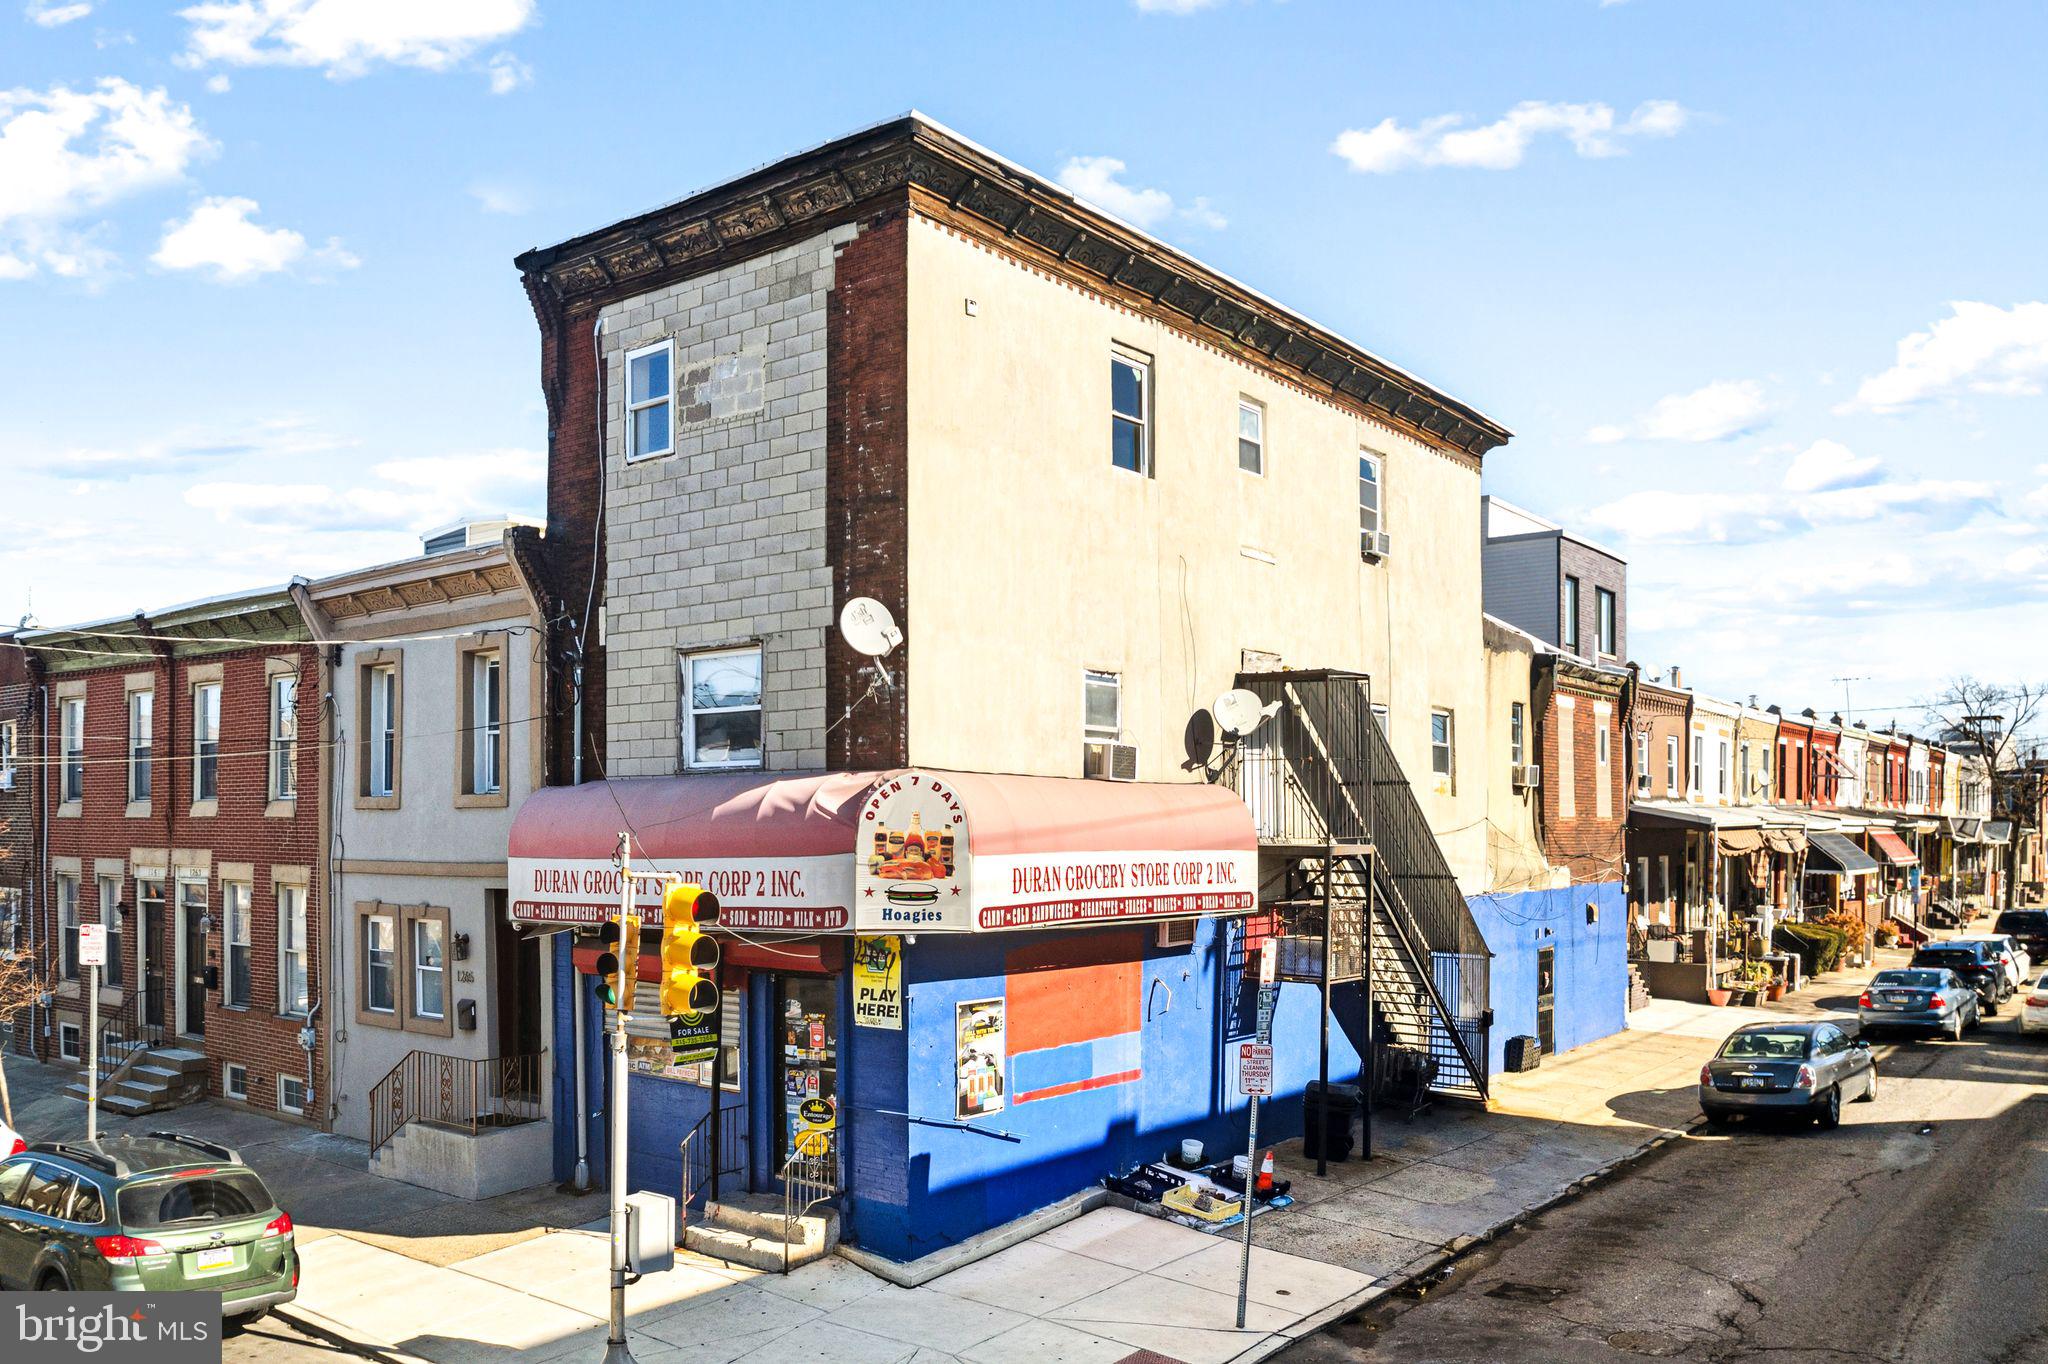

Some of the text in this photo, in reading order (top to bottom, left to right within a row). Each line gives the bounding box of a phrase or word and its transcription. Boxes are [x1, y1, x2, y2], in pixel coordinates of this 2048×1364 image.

[865, 776, 963, 824] OPEN 7 DAYS
[534, 869, 579, 894] DURAN
[584, 870, 647, 896] GROCY
[709, 870, 750, 897] CORP
[756, 871, 765, 897] 2
[771, 870, 805, 898] INC.
[1012, 861, 1237, 894] DURAN GROCERY STORE CORP 2 INC.
[515, 903, 534, 918] CANDY
[540, 905, 556, 919] COLD
[558, 905, 598, 921] SANDWICHES
[729, 910, 749, 926] SODA
[758, 910, 784, 927] BREAD
[793, 911, 814, 927] MILK
[824, 910, 842, 926] ATM
[882, 908, 942, 924] Hoagies
[982, 909, 1005, 927] CANDY
[1012, 906, 1030, 925] COLD
[1032, 902, 1074, 922] SANDWICHES
[1081, 899, 1119, 917] CIGARETTES
[860, 987, 897, 1002] PLAY
[856, 1002, 899, 1018] HERE!
[693, 1026, 709, 1034] SALE
[1241, 1046, 1270, 1057] NO PARKING
